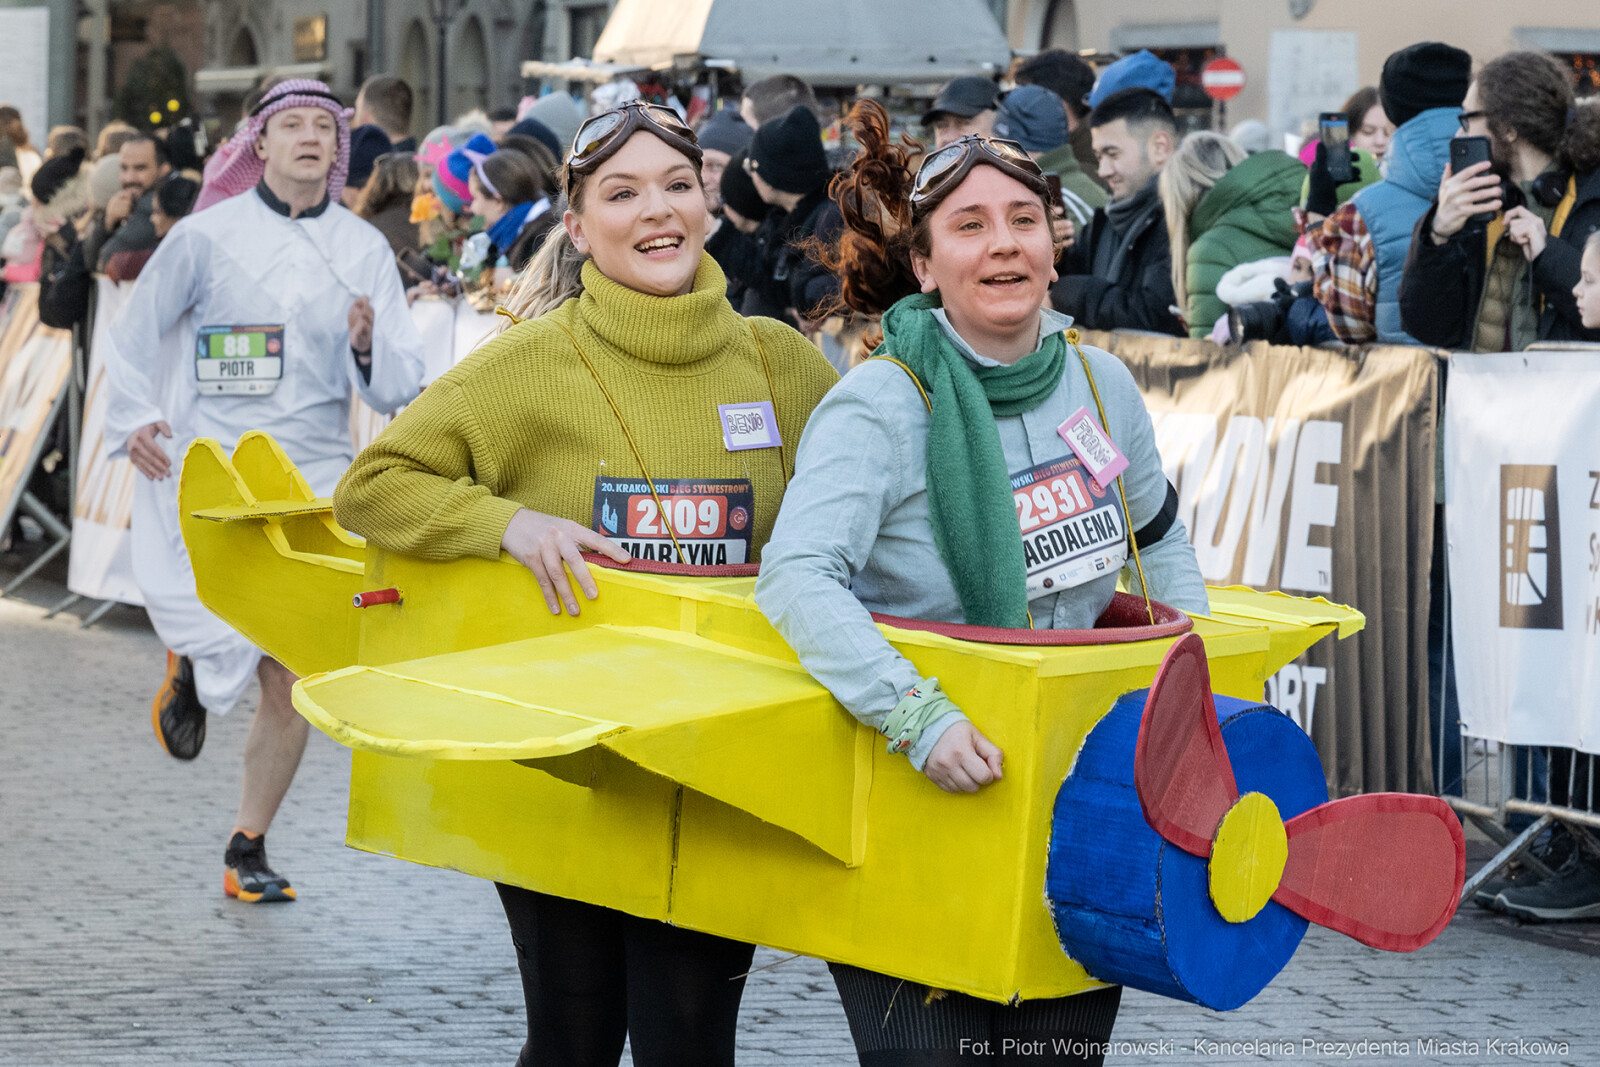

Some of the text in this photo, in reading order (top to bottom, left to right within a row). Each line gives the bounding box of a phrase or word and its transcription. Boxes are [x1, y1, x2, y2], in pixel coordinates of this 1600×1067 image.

[223, 334, 251, 357] 88
[219, 361, 255, 376] PIOTR
[1033, 467, 1051, 481] BIEG
[601, 482, 616, 493] 20.
[670, 484, 691, 494] BIEG
[692, 483, 749, 494] SYLWESTROWY
[1013, 474, 1088, 532] 2931
[635, 498, 720, 536] 2109
[1022, 509, 1119, 569] AGDALENA
[620, 541, 727, 566] MARTYNA
